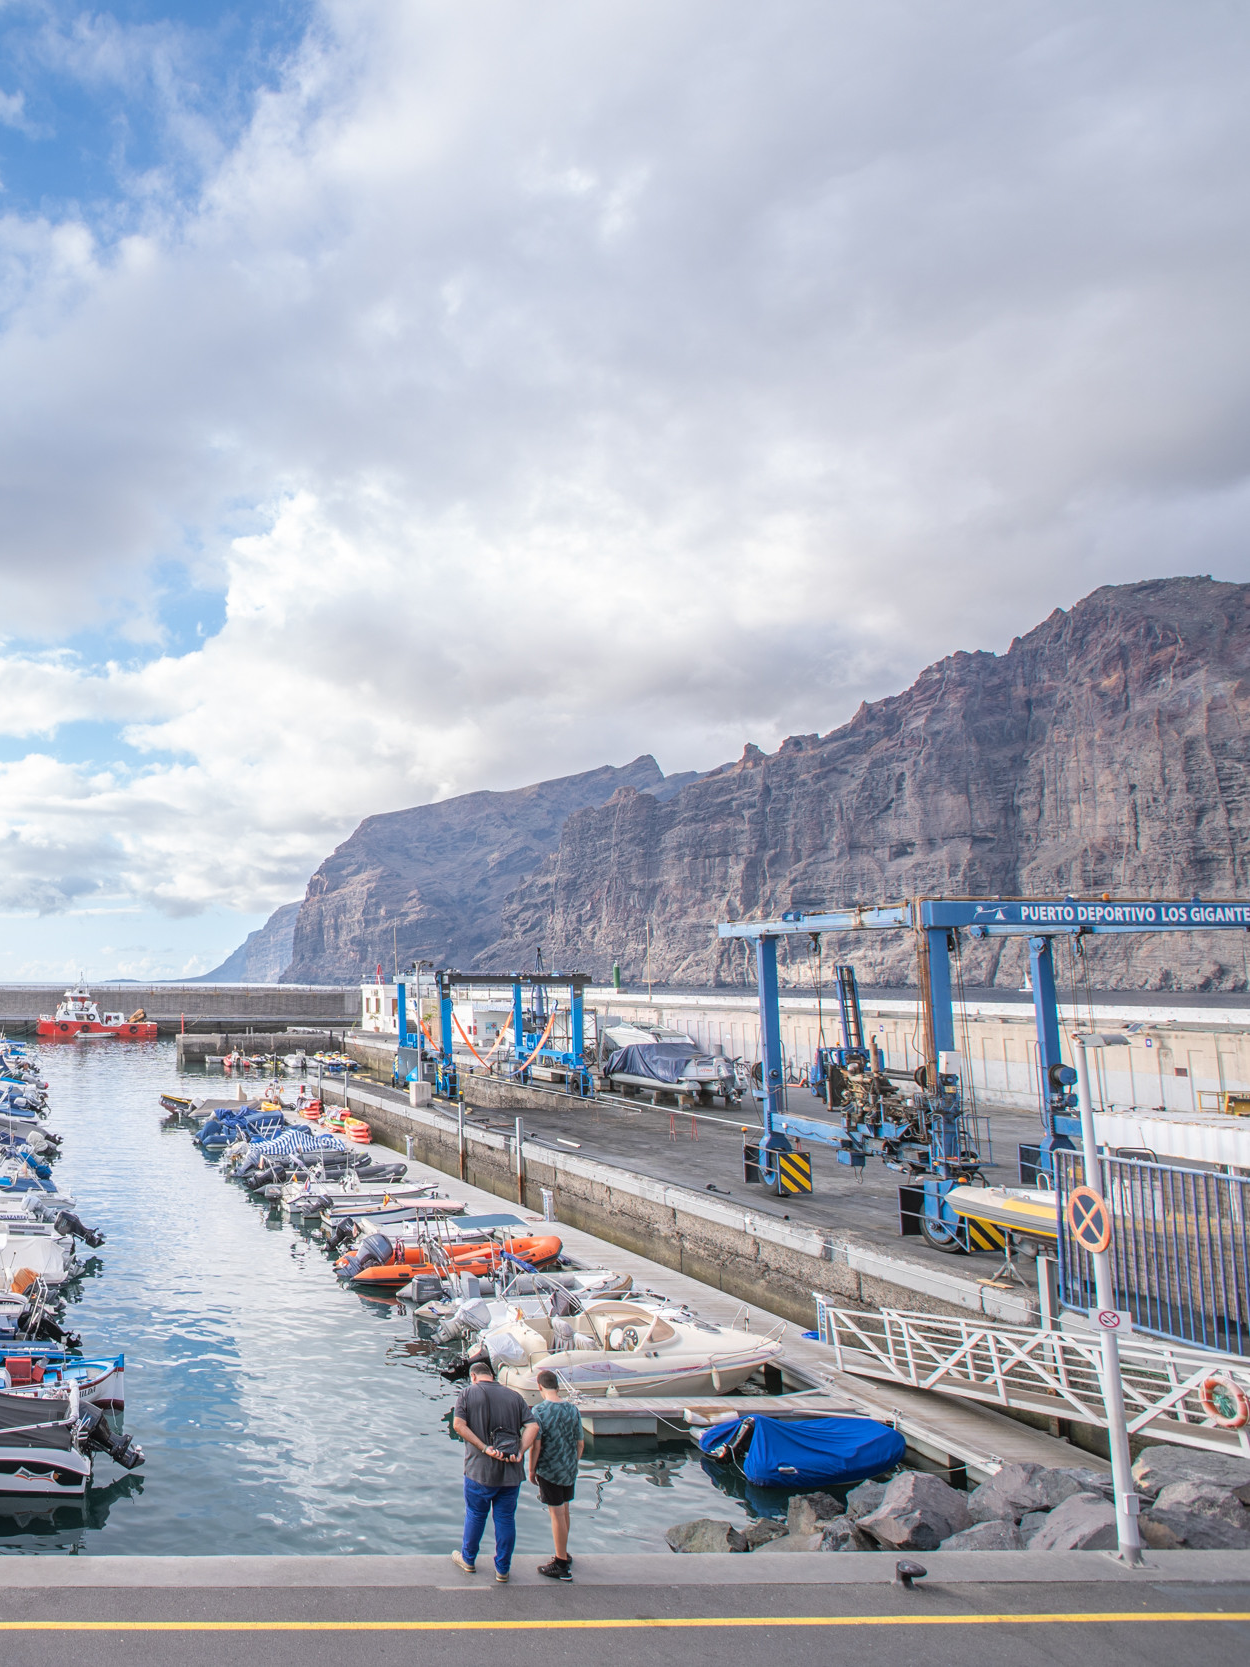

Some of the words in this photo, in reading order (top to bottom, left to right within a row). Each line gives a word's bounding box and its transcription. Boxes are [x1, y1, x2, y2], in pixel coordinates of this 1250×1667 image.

[1020, 906, 1075, 921] PUERTO
[1077, 906, 1157, 922] DEPORTIVO
[1161, 907, 1187, 922] LOS
